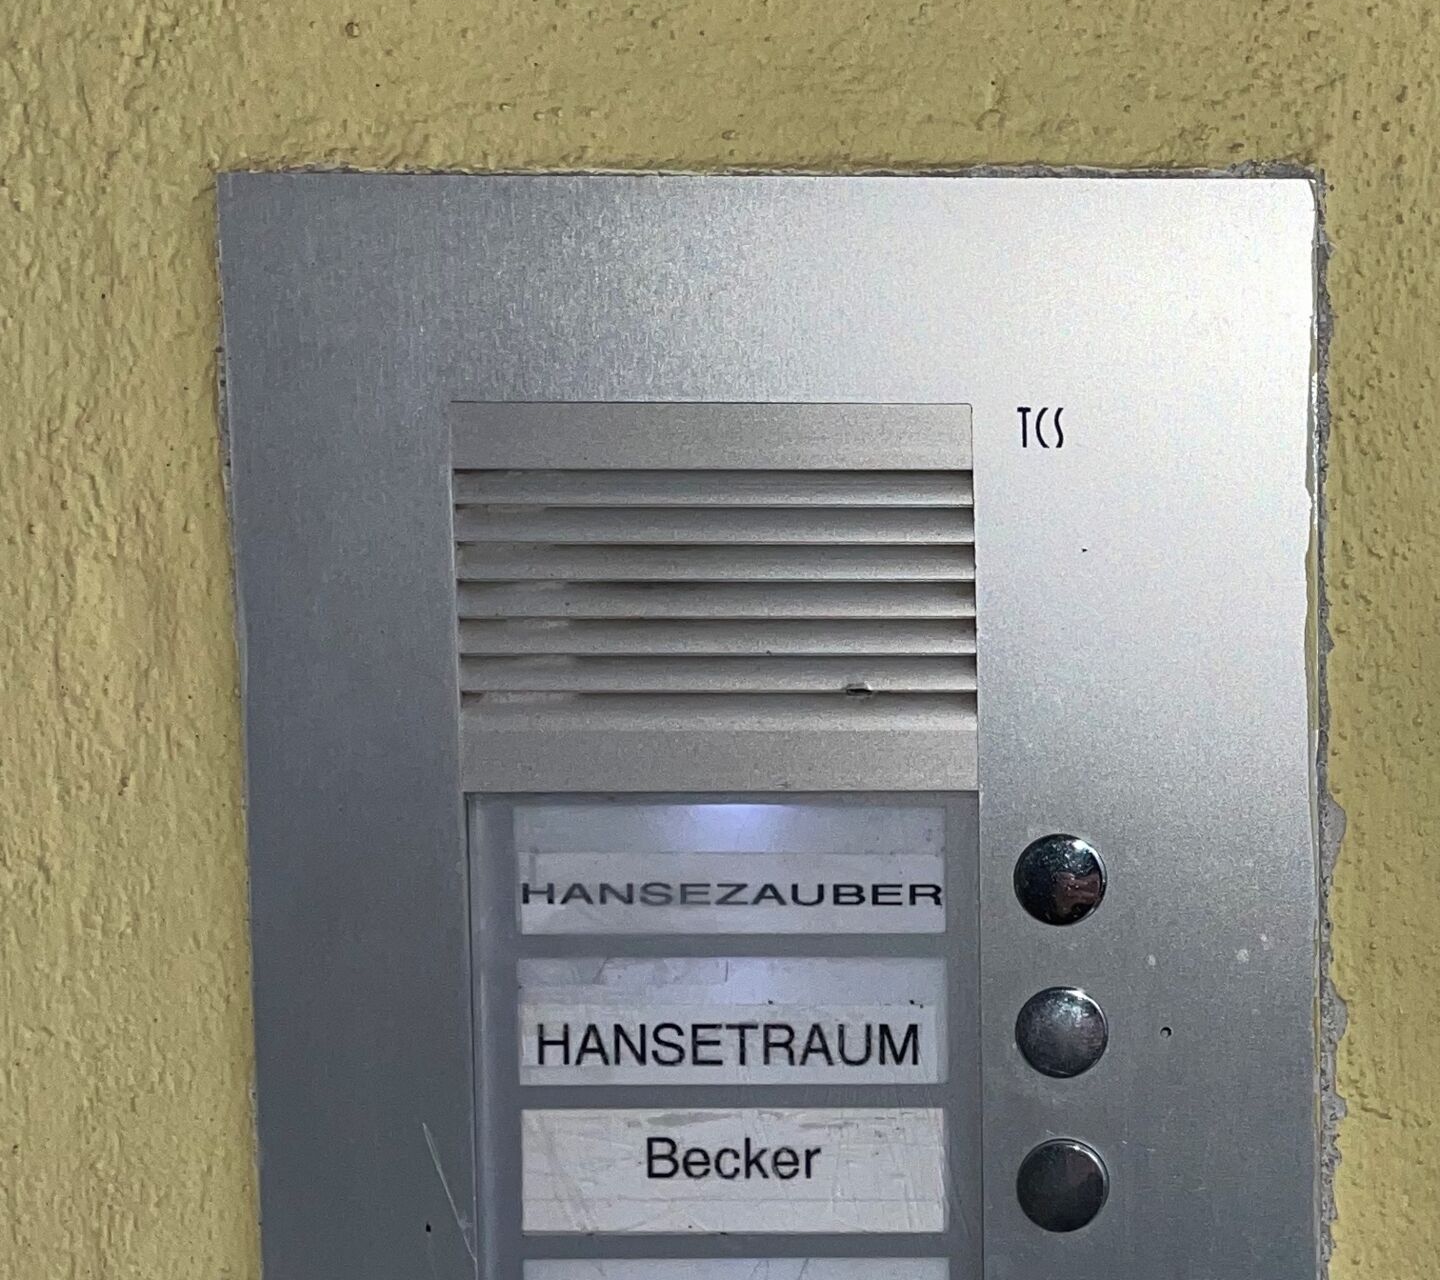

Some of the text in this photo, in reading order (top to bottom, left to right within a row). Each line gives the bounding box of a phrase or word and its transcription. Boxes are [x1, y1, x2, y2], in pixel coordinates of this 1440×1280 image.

[1016, 406, 1064, 449] TCS
[521, 881, 944, 907] HANSEZAUBER
[537, 1022, 920, 1067] HANSETRAUM
[646, 1136, 822, 1181] Becker
